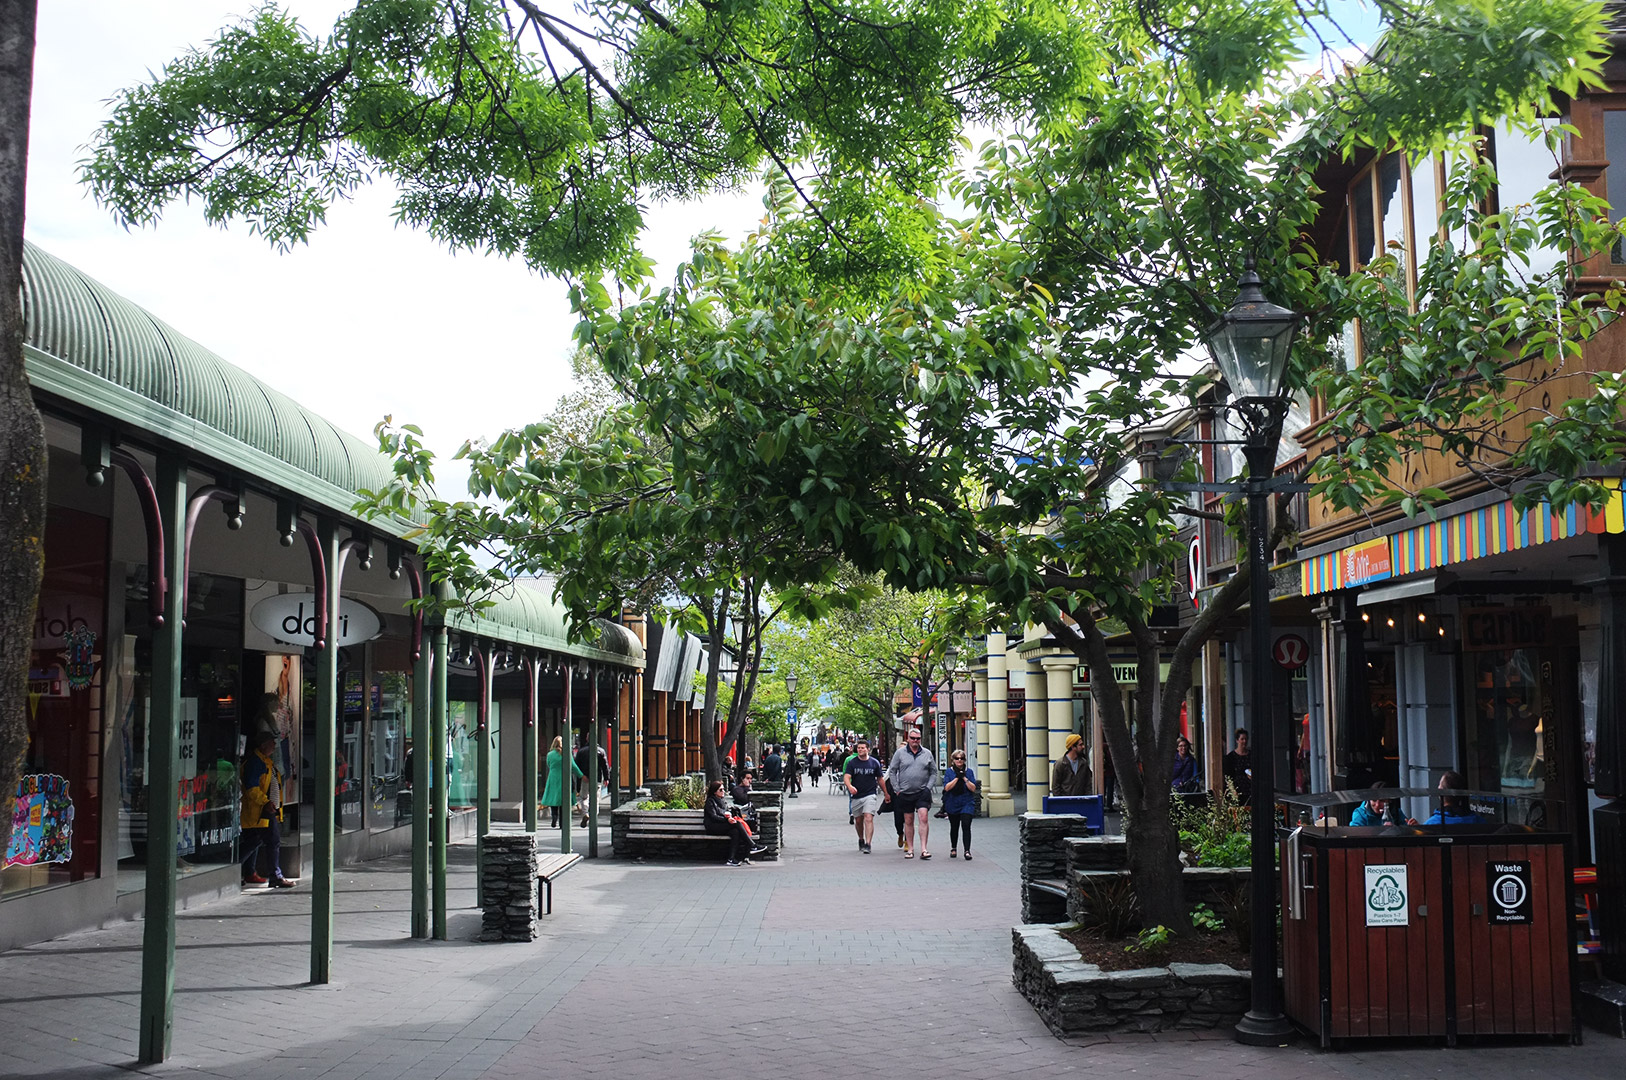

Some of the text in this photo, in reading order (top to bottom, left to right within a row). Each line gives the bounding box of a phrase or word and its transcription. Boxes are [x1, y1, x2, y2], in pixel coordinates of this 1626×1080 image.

[282, 602, 349, 639] doi
[1111, 667, 1139, 681] VEN
[1367, 867, 1405, 875] Recyclables
[1494, 864, 1522, 872] Waste
